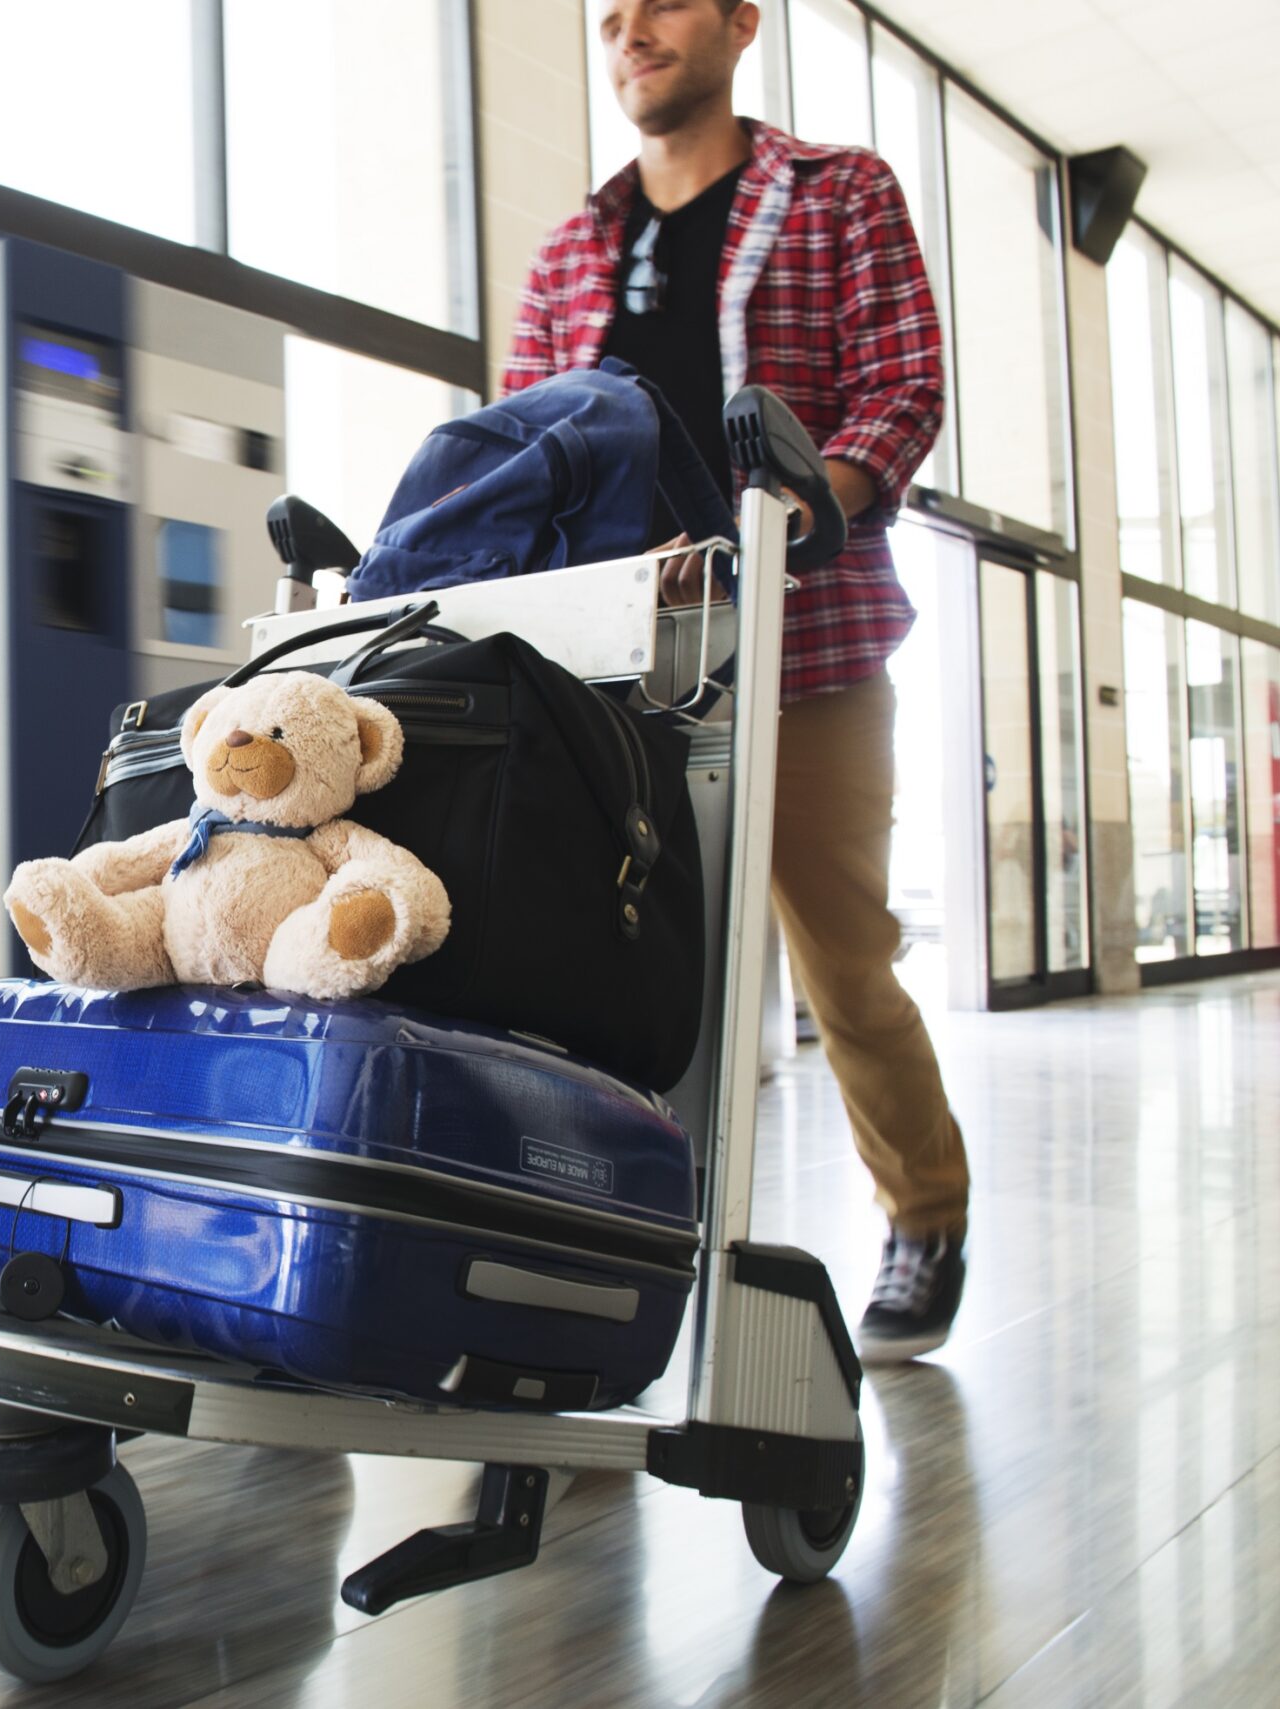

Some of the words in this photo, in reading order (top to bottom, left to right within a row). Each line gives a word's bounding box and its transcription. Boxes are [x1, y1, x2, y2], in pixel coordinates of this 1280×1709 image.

[527, 1153, 557, 1170] EUROPE
[558, 1161, 565, 1173] IN
[567, 1164, 589, 1180] MADE
